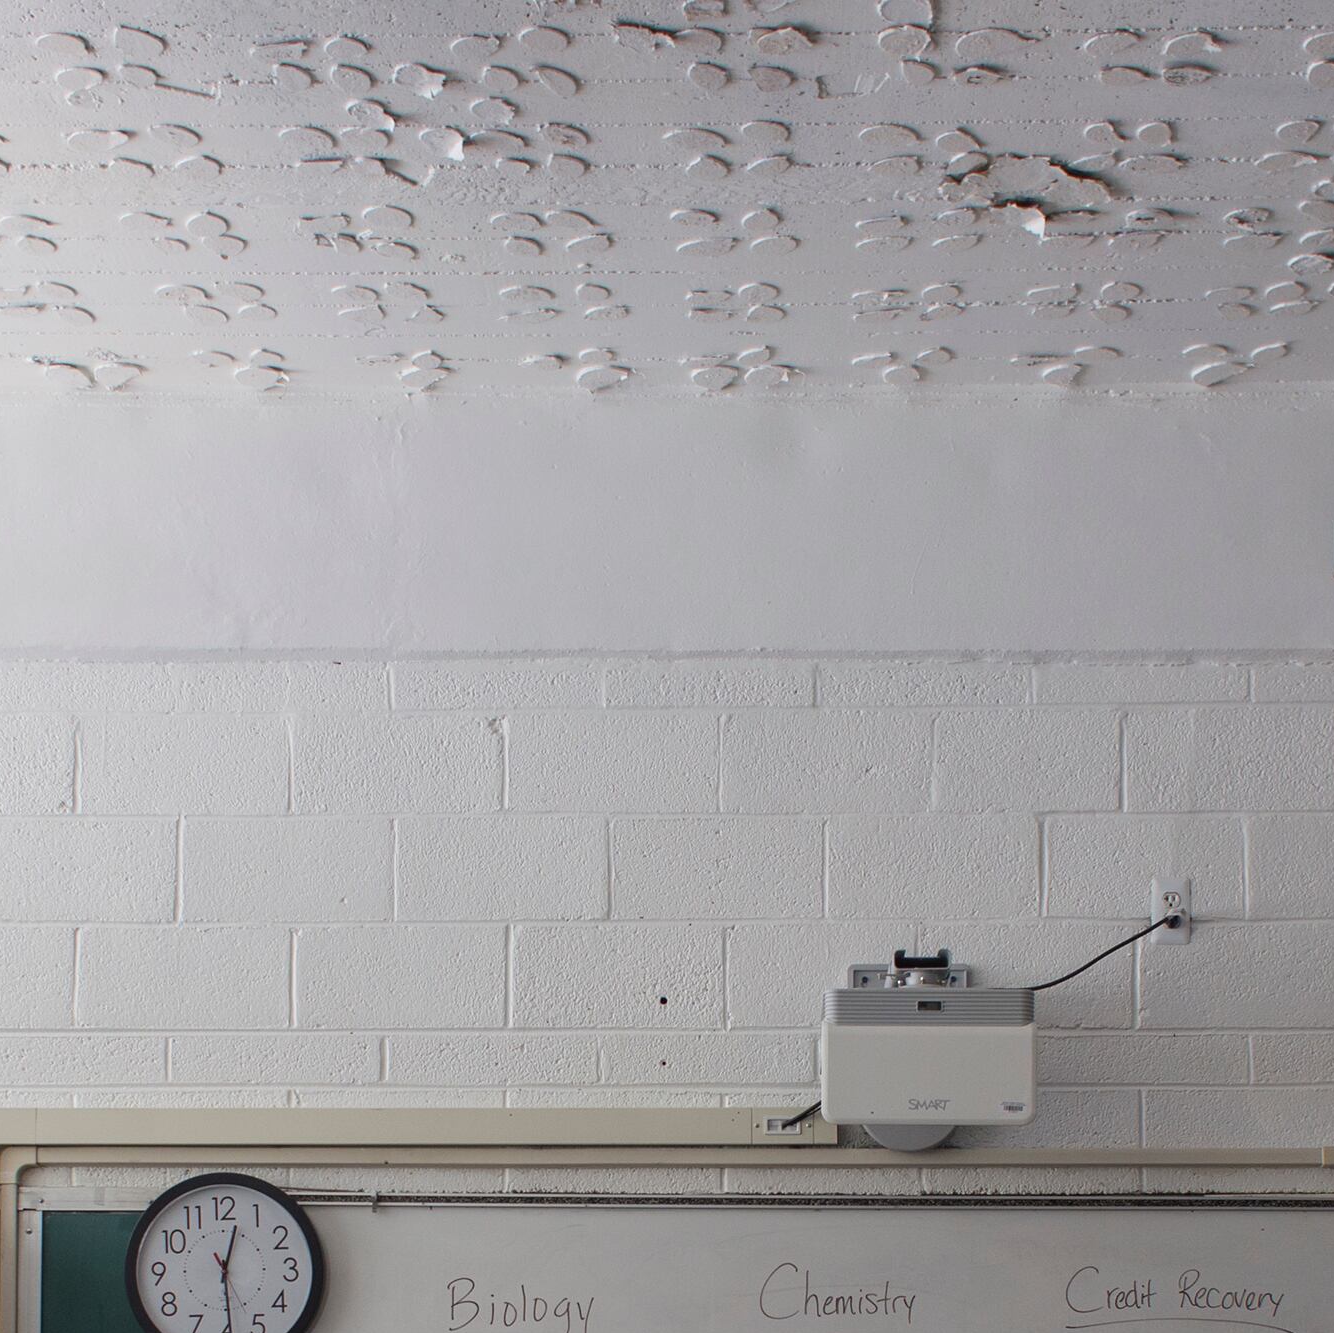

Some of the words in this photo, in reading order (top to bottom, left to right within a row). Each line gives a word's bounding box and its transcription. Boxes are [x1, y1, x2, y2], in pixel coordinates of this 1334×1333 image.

[908, 1098, 951, 1112] SMART
[183, 1205, 202, 1230] 11
[211, 1196, 236, 1221] 12
[252, 1203, 260, 1228] 1
[162, 1229, 186, 1254] 10
[272, 1225, 290, 1250] 2
[151, 1261, 166, 1287] 9
[283, 1257, 299, 1282] 3
[161, 1291, 178, 1317] 8
[271, 1288, 288, 1313] 4
[759, 1262, 917, 1324] Chemistry
[1065, 1266, 1157, 1313] Credit
[1178, 1268, 1285, 1317] Recovery
